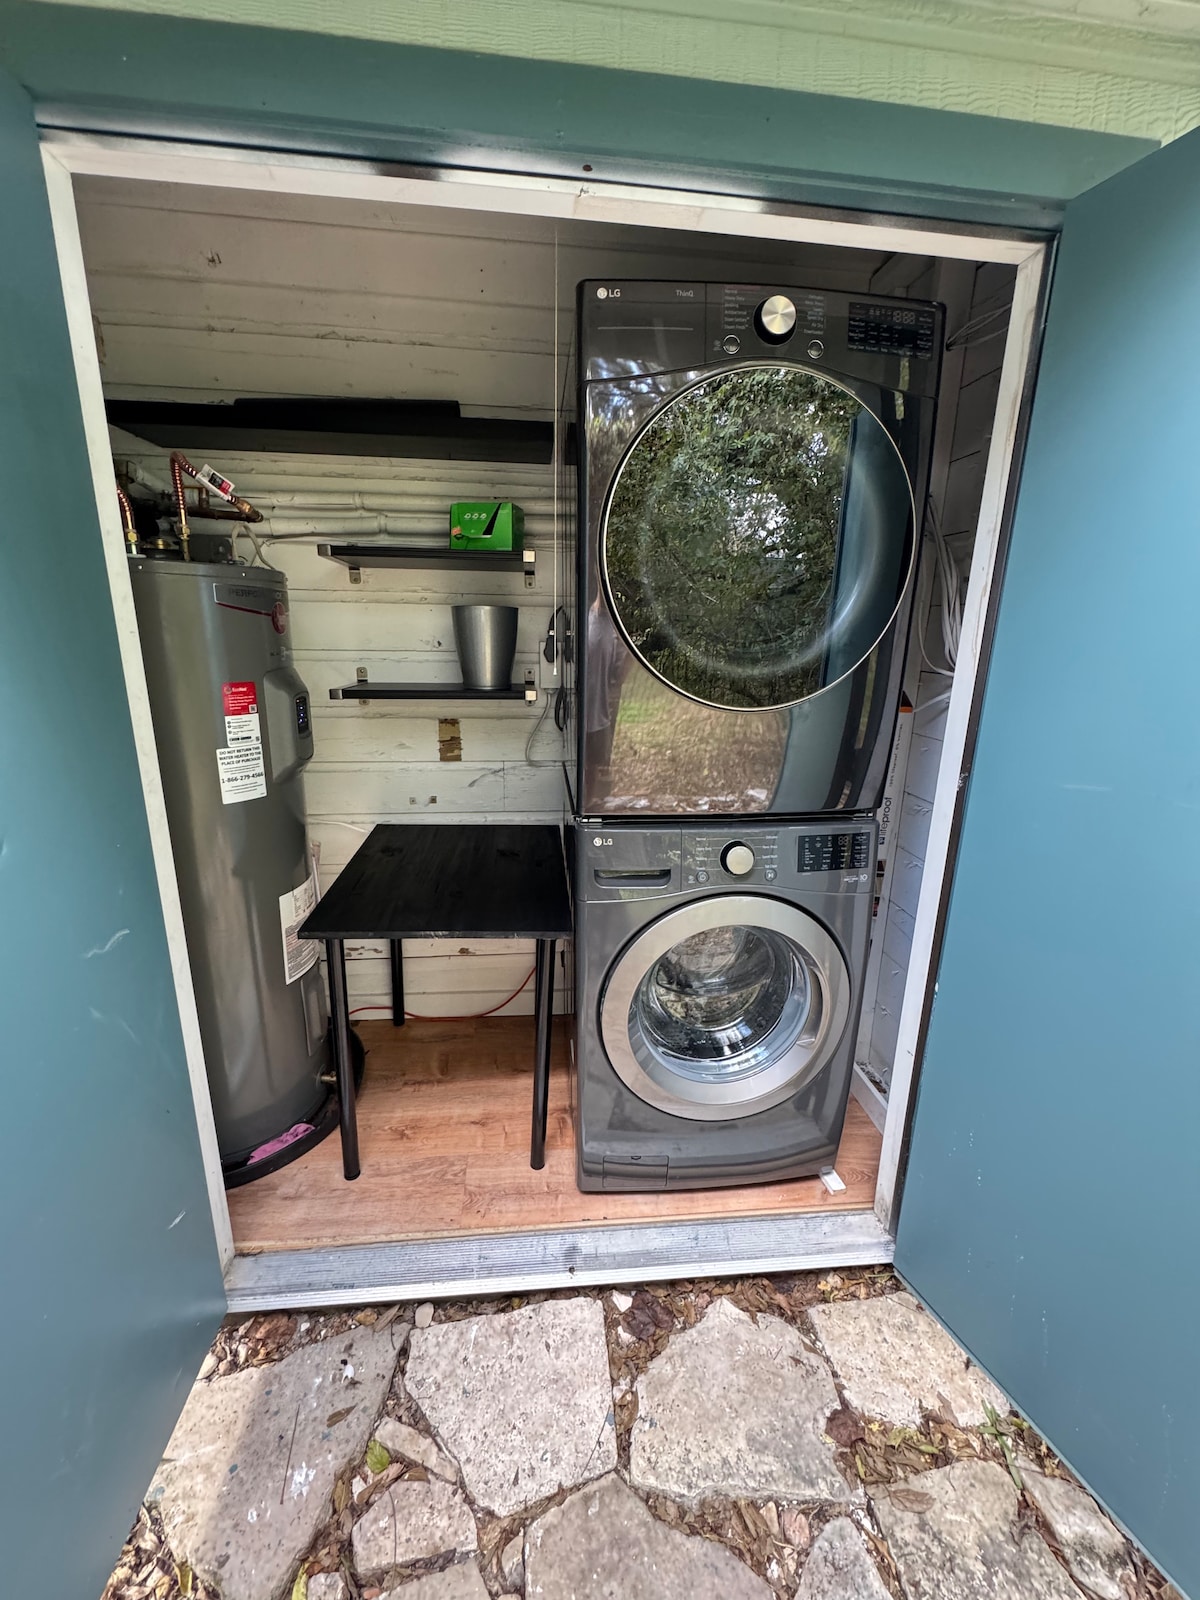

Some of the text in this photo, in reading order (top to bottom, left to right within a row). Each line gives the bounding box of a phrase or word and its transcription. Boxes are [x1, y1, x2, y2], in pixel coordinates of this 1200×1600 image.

[608, 288, 621, 298] LG
[675, 289, 694, 298] ThinQ
[879, 797, 893, 836] lifeproof
